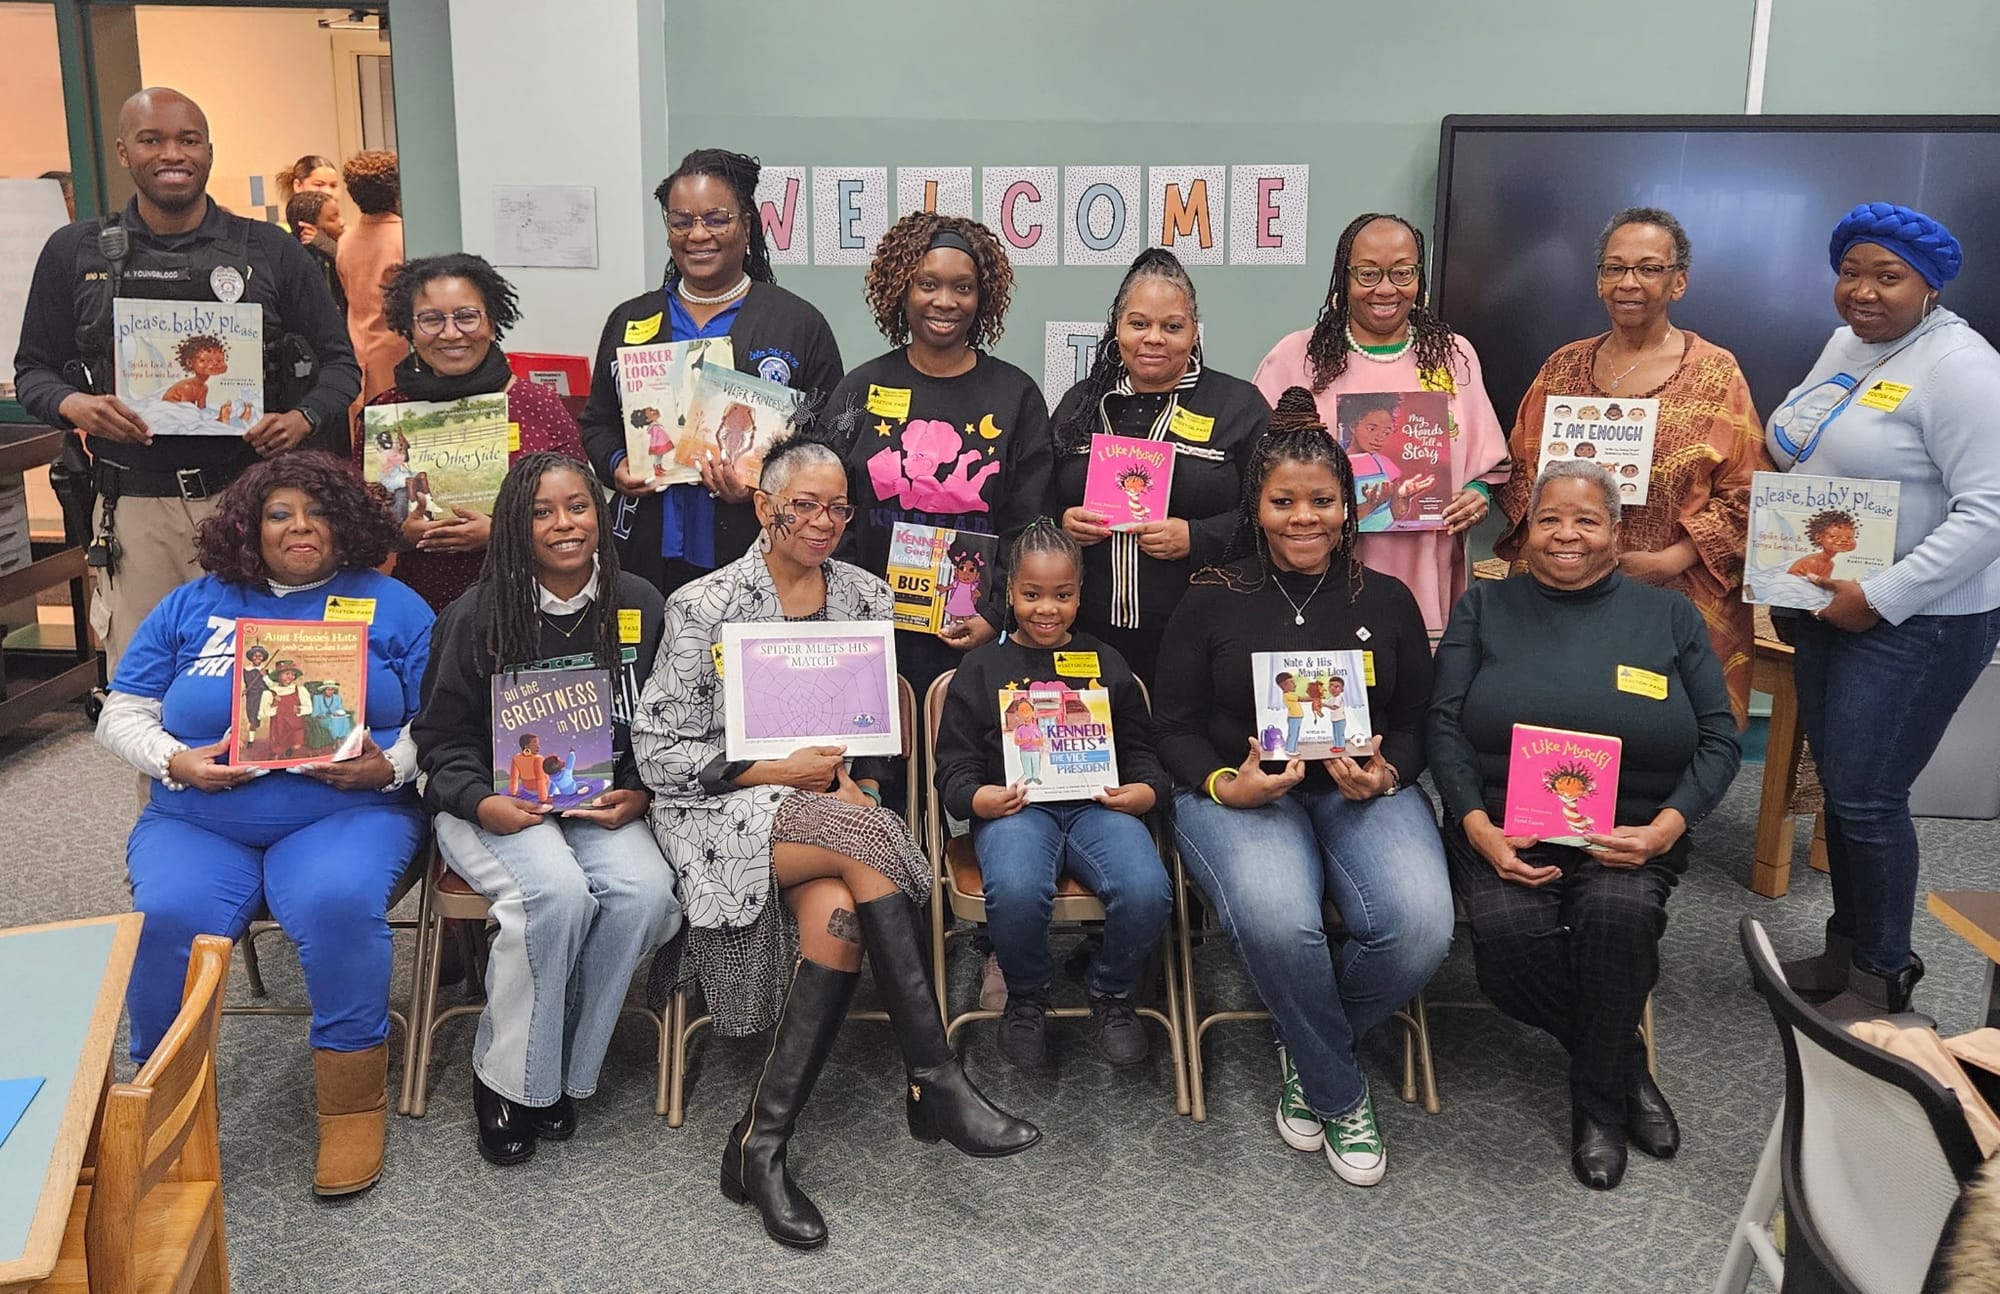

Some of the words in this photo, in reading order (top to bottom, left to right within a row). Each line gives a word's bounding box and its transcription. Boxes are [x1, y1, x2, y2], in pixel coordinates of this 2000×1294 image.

[119, 315, 171, 343] please,
[219, 315, 259, 339] please
[624, 349, 673, 366] PARKER
[625, 364, 667, 380] LOOKS
[627, 380, 643, 393] UP
[723, 382, 748, 402] WATER
[751, 390, 786, 412] PRINCESS
[1409, 414, 1430, 428] My
[1402, 423, 1444, 438] Hands
[1552, 422, 1563, 439] I
[1566, 423, 1585, 440] AM
[1588, 424, 1644, 442] ENOUGH
[1421, 437, 1435, 447] Tell
[418, 448, 436, 463] The
[435, 450, 474, 470] Other
[463, 441, 501, 471] Side
[1098, 451, 1105, 462] I
[1105, 443, 1127, 458] Like
[1128, 445, 1166, 468] Myself!
[1402, 443, 1439, 465] Story
[1754, 486, 1804, 513] please,
[1853, 491, 1894, 518] please
[905, 545, 930, 558] Goes
[897, 575, 931, 592] BUS
[265, 632, 290, 641] Aunt
[332, 633, 358, 642] Hats
[760, 643, 802, 656] SPIDER
[805, 643, 844, 655] MEETS
[848, 642, 869, 654] HIS
[791, 656, 836, 668] MATCH
[1283, 657, 1304, 668] Nate
[1306, 656, 1314, 668] &
[1316, 657, 1333, 667] His
[1298, 668, 1325, 680] Magic
[1328, 667, 1348, 677] Lion
[504, 689, 518, 704] All
[519, 680, 540, 698] the
[500, 680, 599, 732] GREATNESS
[556, 719, 568, 734] in
[567, 705, 604, 733] YOU
[1051, 738, 1097, 753] MEETS
[1052, 754, 1065, 763] THE
[1065, 752, 1088, 763] VICE
[1521, 746, 1531, 760] I
[1531, 739, 1560, 756] Like
[1561, 742, 1614, 770] Myself!
[1056, 763, 1111, 775] PRESIDENT
